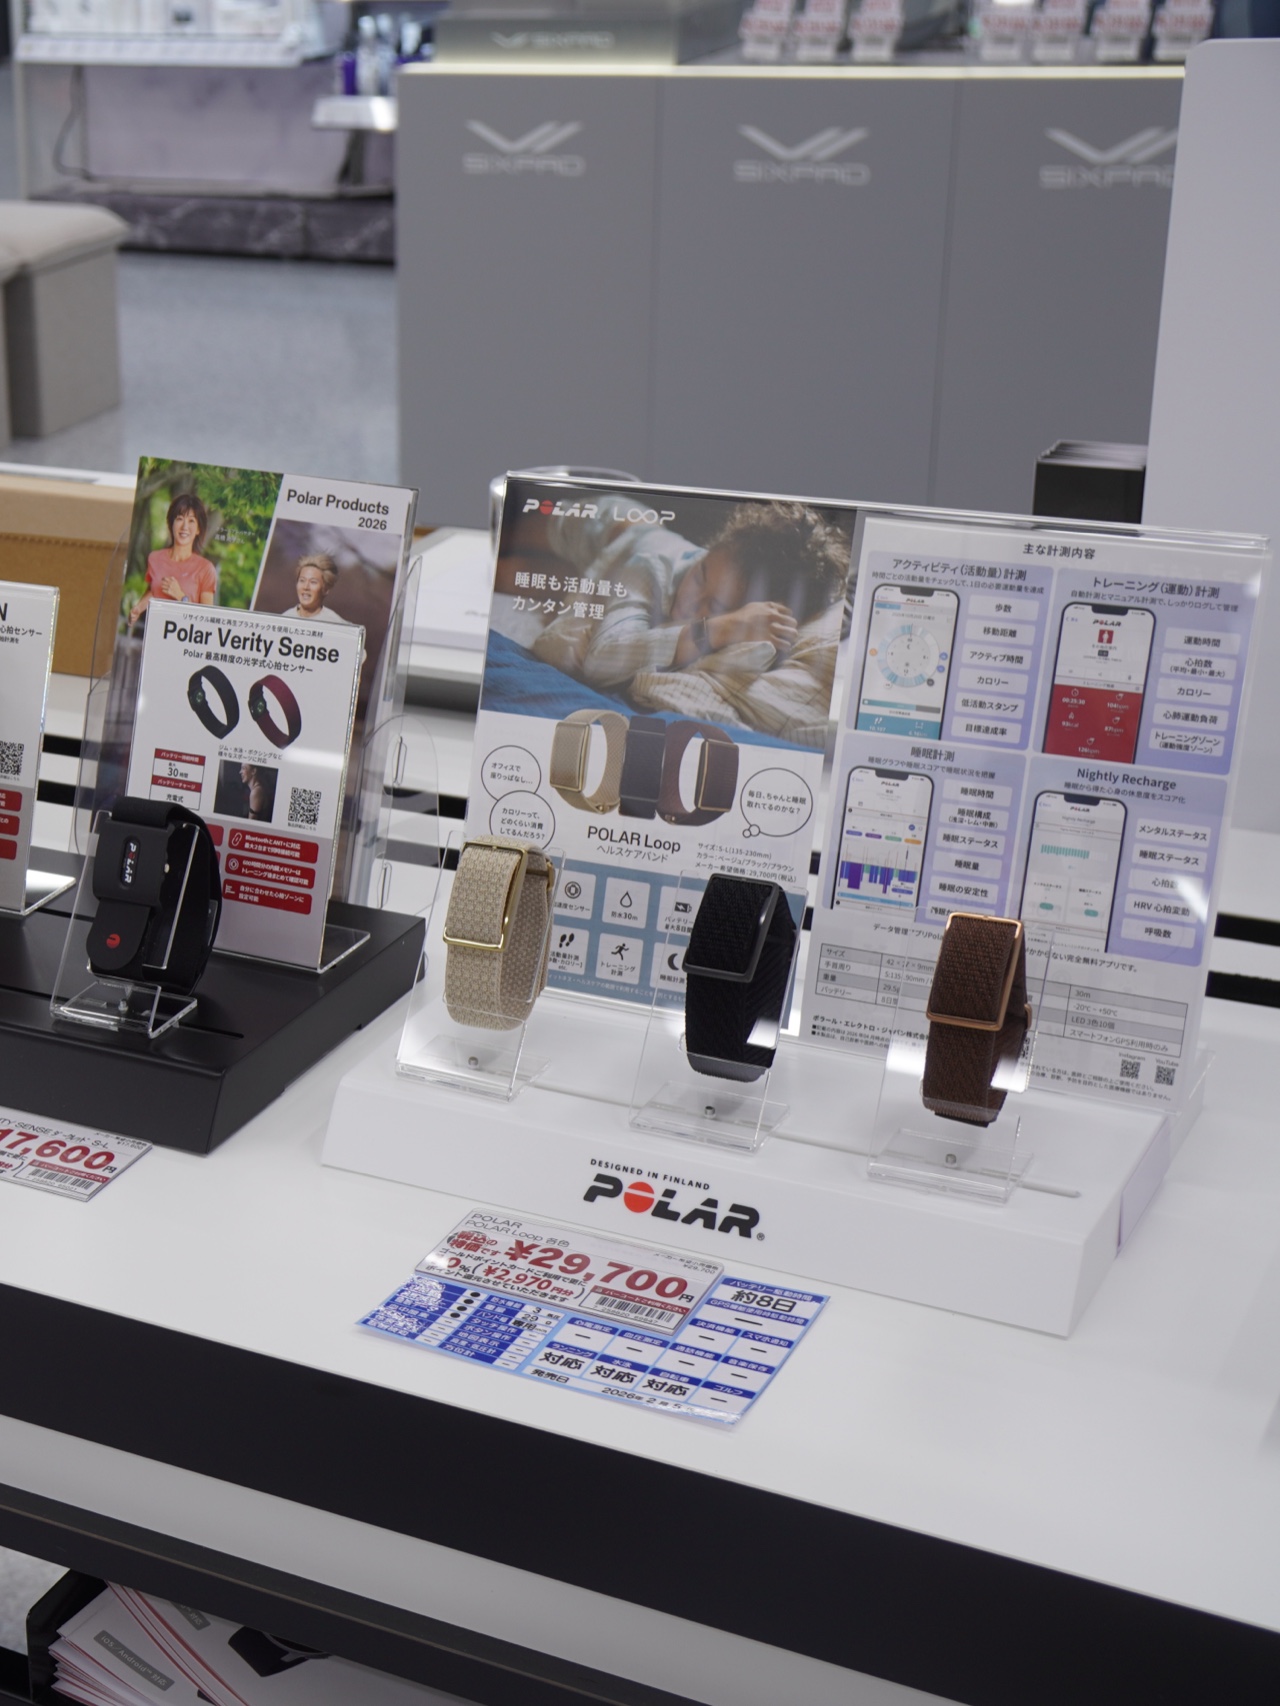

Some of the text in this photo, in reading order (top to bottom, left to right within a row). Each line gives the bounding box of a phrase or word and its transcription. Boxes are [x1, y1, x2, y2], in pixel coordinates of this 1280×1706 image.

[287, 489, 390, 515] Polar Products
[522, 498, 676, 525] POLAR LOOP
[357, 516, 387, 531] 2026
[1023, 543, 1096, 560] 主な計測内容
[515, 571, 628, 598] 睡眠も活動量も
[512, 596, 605, 620] カンタン管理
[995, 602, 1012, 614] 歩数
[983, 625, 1018, 638] 移動距離
[163, 620, 340, 663] Polar Verity Sense
[1183, 635, 1221, 648] 運動時間
[183, 649, 313, 673] Polar 最高精度の光学式心拍センサー
[969, 651, 1024, 665] アクティブ時間
[1185, 657, 1213, 669] 心拍数
[977, 675, 1009, 686] カロリー
[1177, 687, 1212, 697] カロリー
[961, 698, 1019, 713] 低活動スタンプ
[1163, 710, 1218, 725] 心肺運動負荷
[965, 723, 1008, 736] 目標達成率
[910, 746, 956, 763] 睡眠計測
[167, 767, 179, 777] 30
[491, 762, 521, 772] オフィスで
[1077, 768, 1177, 791] Nightly Recharge
[960, 786, 995, 799] 睡眠時間
[957, 807, 992, 820] 睡眠構成
[587, 826, 681, 853] POLAR Loop
[1138, 824, 1208, 842] メンタルステータス
[942, 833, 999, 849] 睡眠ステータス
[596, 845, 669, 863] ヘルスケアバンド
[1139, 850, 1200, 866] 睡眠ステータス
[124, 842, 137, 883] POLAR
[954, 859, 980, 871] 睡眠量
[938, 882, 989, 898] 睡眠の安定性
[1133, 901, 1153, 911] HRV
[610, 910, 639, 922] 防水30m
[1144, 926, 1172, 939] 呼吸数
[826, 948, 846, 958] サイズ
[600, 961, 637, 973] トレーニング
[821, 986, 853, 996] バッテリー
[1074, 989, 1091, 999] 30m
[1071, 1015, 1086, 1025] LED
[14, 1122, 54, 1135] SENSE
[590, 1158, 711, 1190] DESIGNED IN FINLAND
[583, 1173, 760, 1239] POLAR
[471, 1213, 523, 1229] POLAR
[465, 1220, 510, 1234] POLAR
[511, 1229, 543, 1242] Loop
[504, 1239, 695, 1303] ¥29,700円
[730, 1290, 797, 1313] 約8日
[521, 1313, 539, 1322] 29
[539, 1351, 586, 1371] 対応
[530, 1368, 570, 1384] 発売日
[590, 1364, 638, 1385] 対応
[601, 1386, 643, 1401] 2026年
[642, 1378, 691, 1398] 対応
[713, 1383, 744, 1396] ゴルフ
